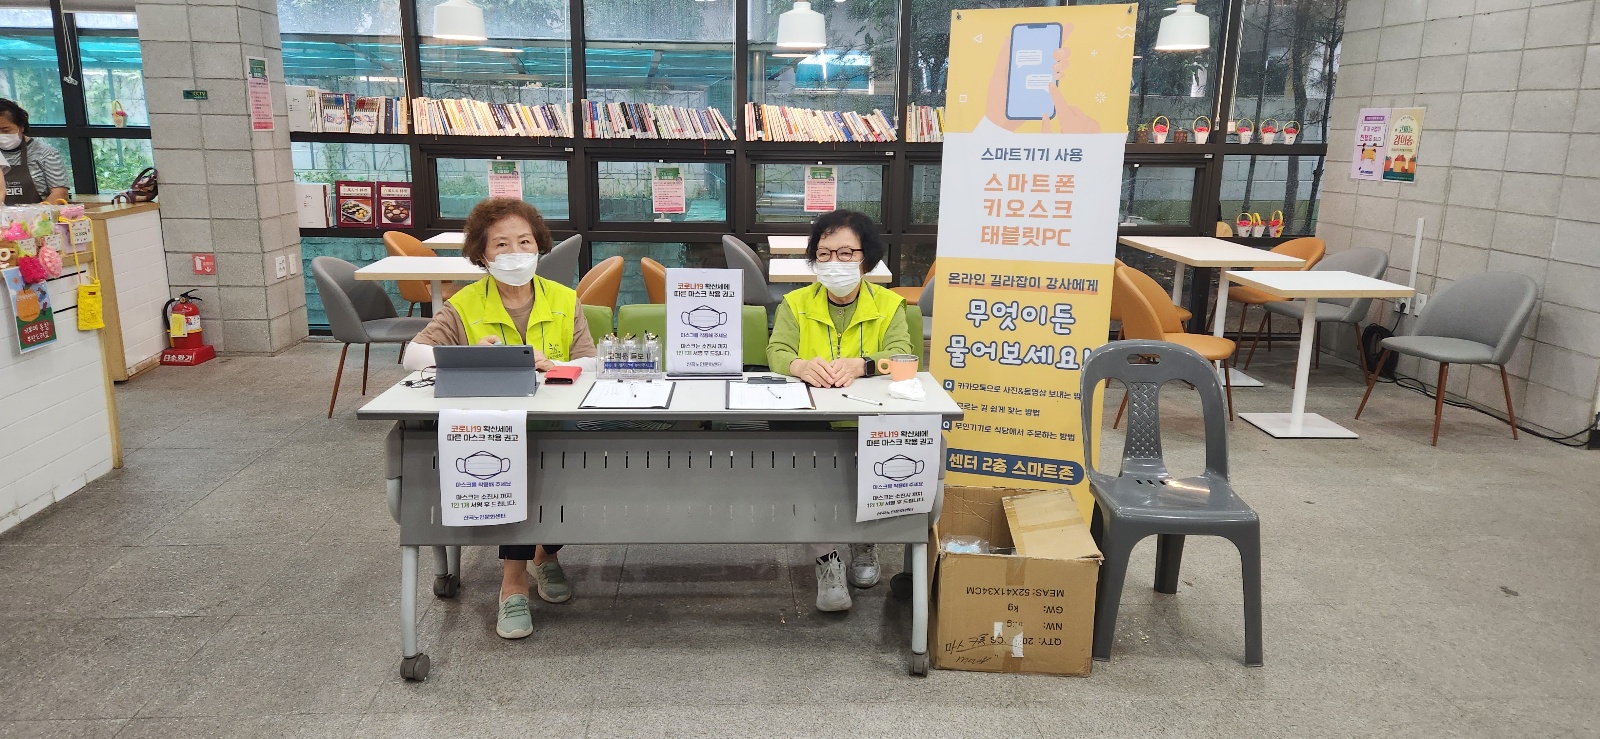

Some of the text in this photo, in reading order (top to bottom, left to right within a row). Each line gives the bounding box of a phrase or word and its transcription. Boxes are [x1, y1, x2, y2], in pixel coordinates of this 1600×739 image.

[981, 148, 1083, 162] 스마트기기 사용
[984, 173, 1075, 194] 스마트폰
[983, 198, 1073, 219] 키오스크
[981, 225, 1072, 247] 태블릿PC
[677, 282, 704, 290] 코로나19
[948, 272, 1099, 292] 온라인 길라잡이 강사에게
[688, 290, 707, 298] 마스크
[966, 299, 1076, 335] 무엇이든
[957, 382, 1001, 393] 카카오톡으로
[1003, 386, 1047, 397] 사진&동영상
[1048, 390, 1072, 400] 보내는
[990, 405, 1006, 414] 쉽게
[1007, 406, 1022, 416] 찾는
[1024, 409, 1040, 417] 방법
[451, 425, 513, 433] 코로나19 확산세에
[870, 430, 929, 439] 코로나19 확산세에
[955, 422, 992, 433] 무인기기로
[994, 426, 1025, 436] 식당에서
[1026, 429, 1057, 440] 주문하는
[1059, 433, 1075, 441] 방법
[463, 434, 485, 442] 마스크
[487, 434, 502, 442] 착용
[503, 434, 519, 442] 권고
[866, 438, 880, 447] 따른
[881, 439, 903, 447] 마스크
[919, 437, 934, 446] 권고
[949, 453, 1075, 481] 센터 2층 스마트존
[966, 586, 1065, 598] MEAS: 52X41X34CM
[1007, 603, 1064, 614] GW: kg
[1043, 622, 1063, 631] NW:
[1038, 637, 1062, 646] QTY:
